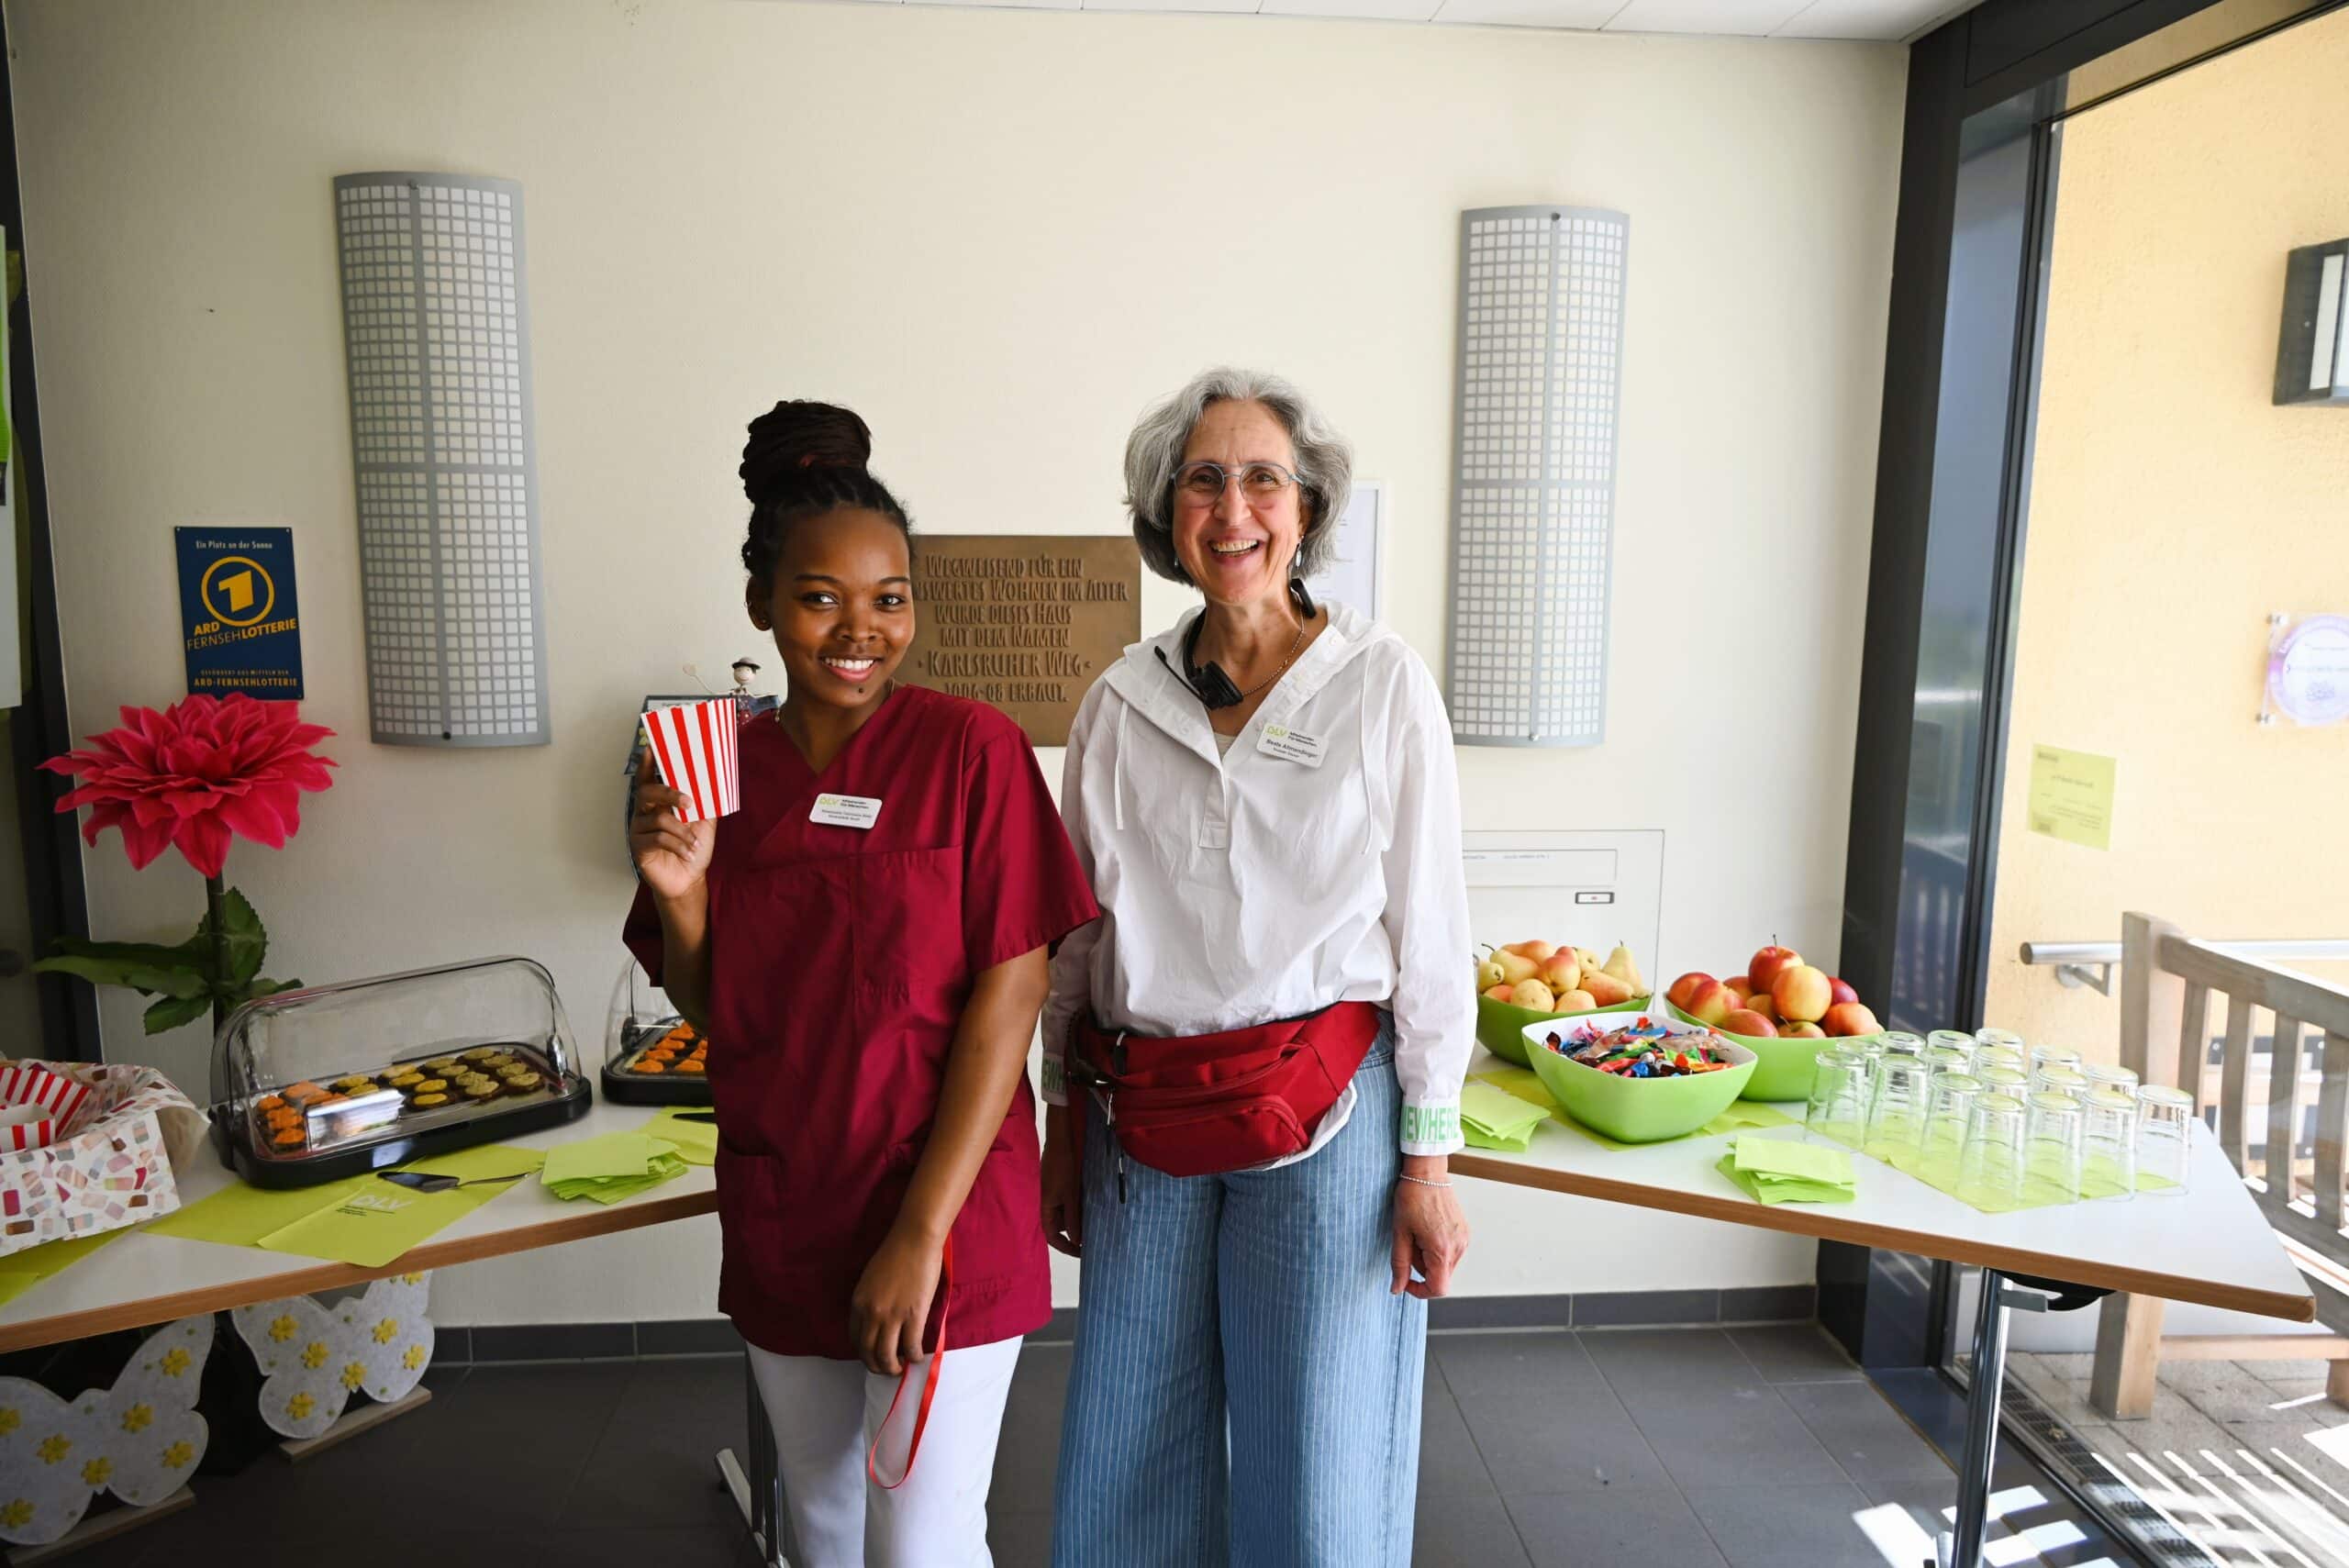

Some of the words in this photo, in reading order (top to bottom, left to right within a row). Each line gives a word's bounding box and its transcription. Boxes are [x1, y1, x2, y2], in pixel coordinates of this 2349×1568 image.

[926, 555, 1025, 578] WEGWEISEND
[1029, 552, 1056, 578] FÜR
[1059, 556, 1084, 578] EIN
[991, 579, 1059, 602] WOHNEN
[1062, 581, 1084, 602] IM
[1086, 579, 1130, 602] ALTER
[935, 604, 985, 625] WURDE
[990, 604, 1030, 625] DIESES
[1035, 603, 1073, 625] HAUS
[187, 617, 297, 651] FERNSEHLOTTERIE
[194, 621, 220, 637] ARD
[940, 627, 970, 648] MIT
[975, 627, 1008, 648] DEM
[1012, 625, 1072, 648] NAMEN
